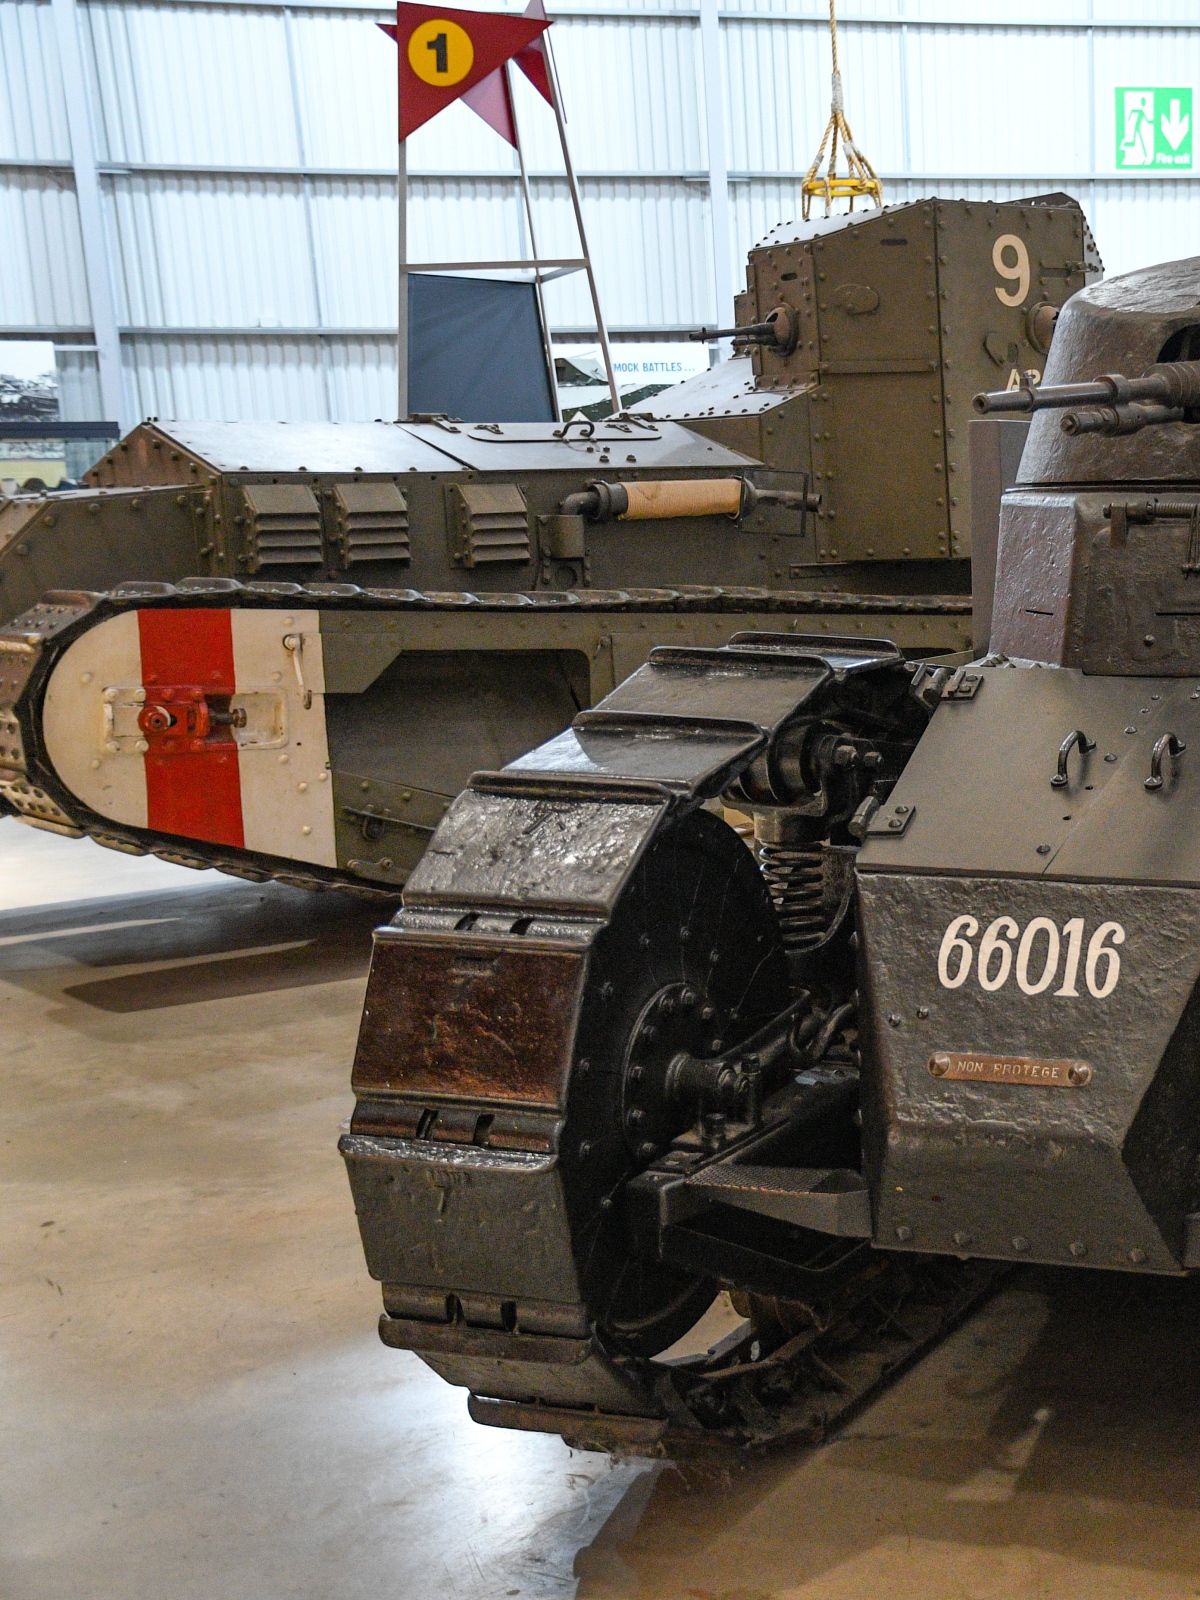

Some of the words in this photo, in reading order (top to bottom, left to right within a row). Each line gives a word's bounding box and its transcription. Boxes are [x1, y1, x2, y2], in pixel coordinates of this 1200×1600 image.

[426, 33, 449, 73] 1
[1156, 152, 1174, 165] Fire
[1173, 153, 1191, 165] exit
[992, 234, 1030, 307] 9
[613, 362, 639, 373] MOCK
[937, 914, 1126, 999] 66016
[957, 1061, 984, 1073] NON
